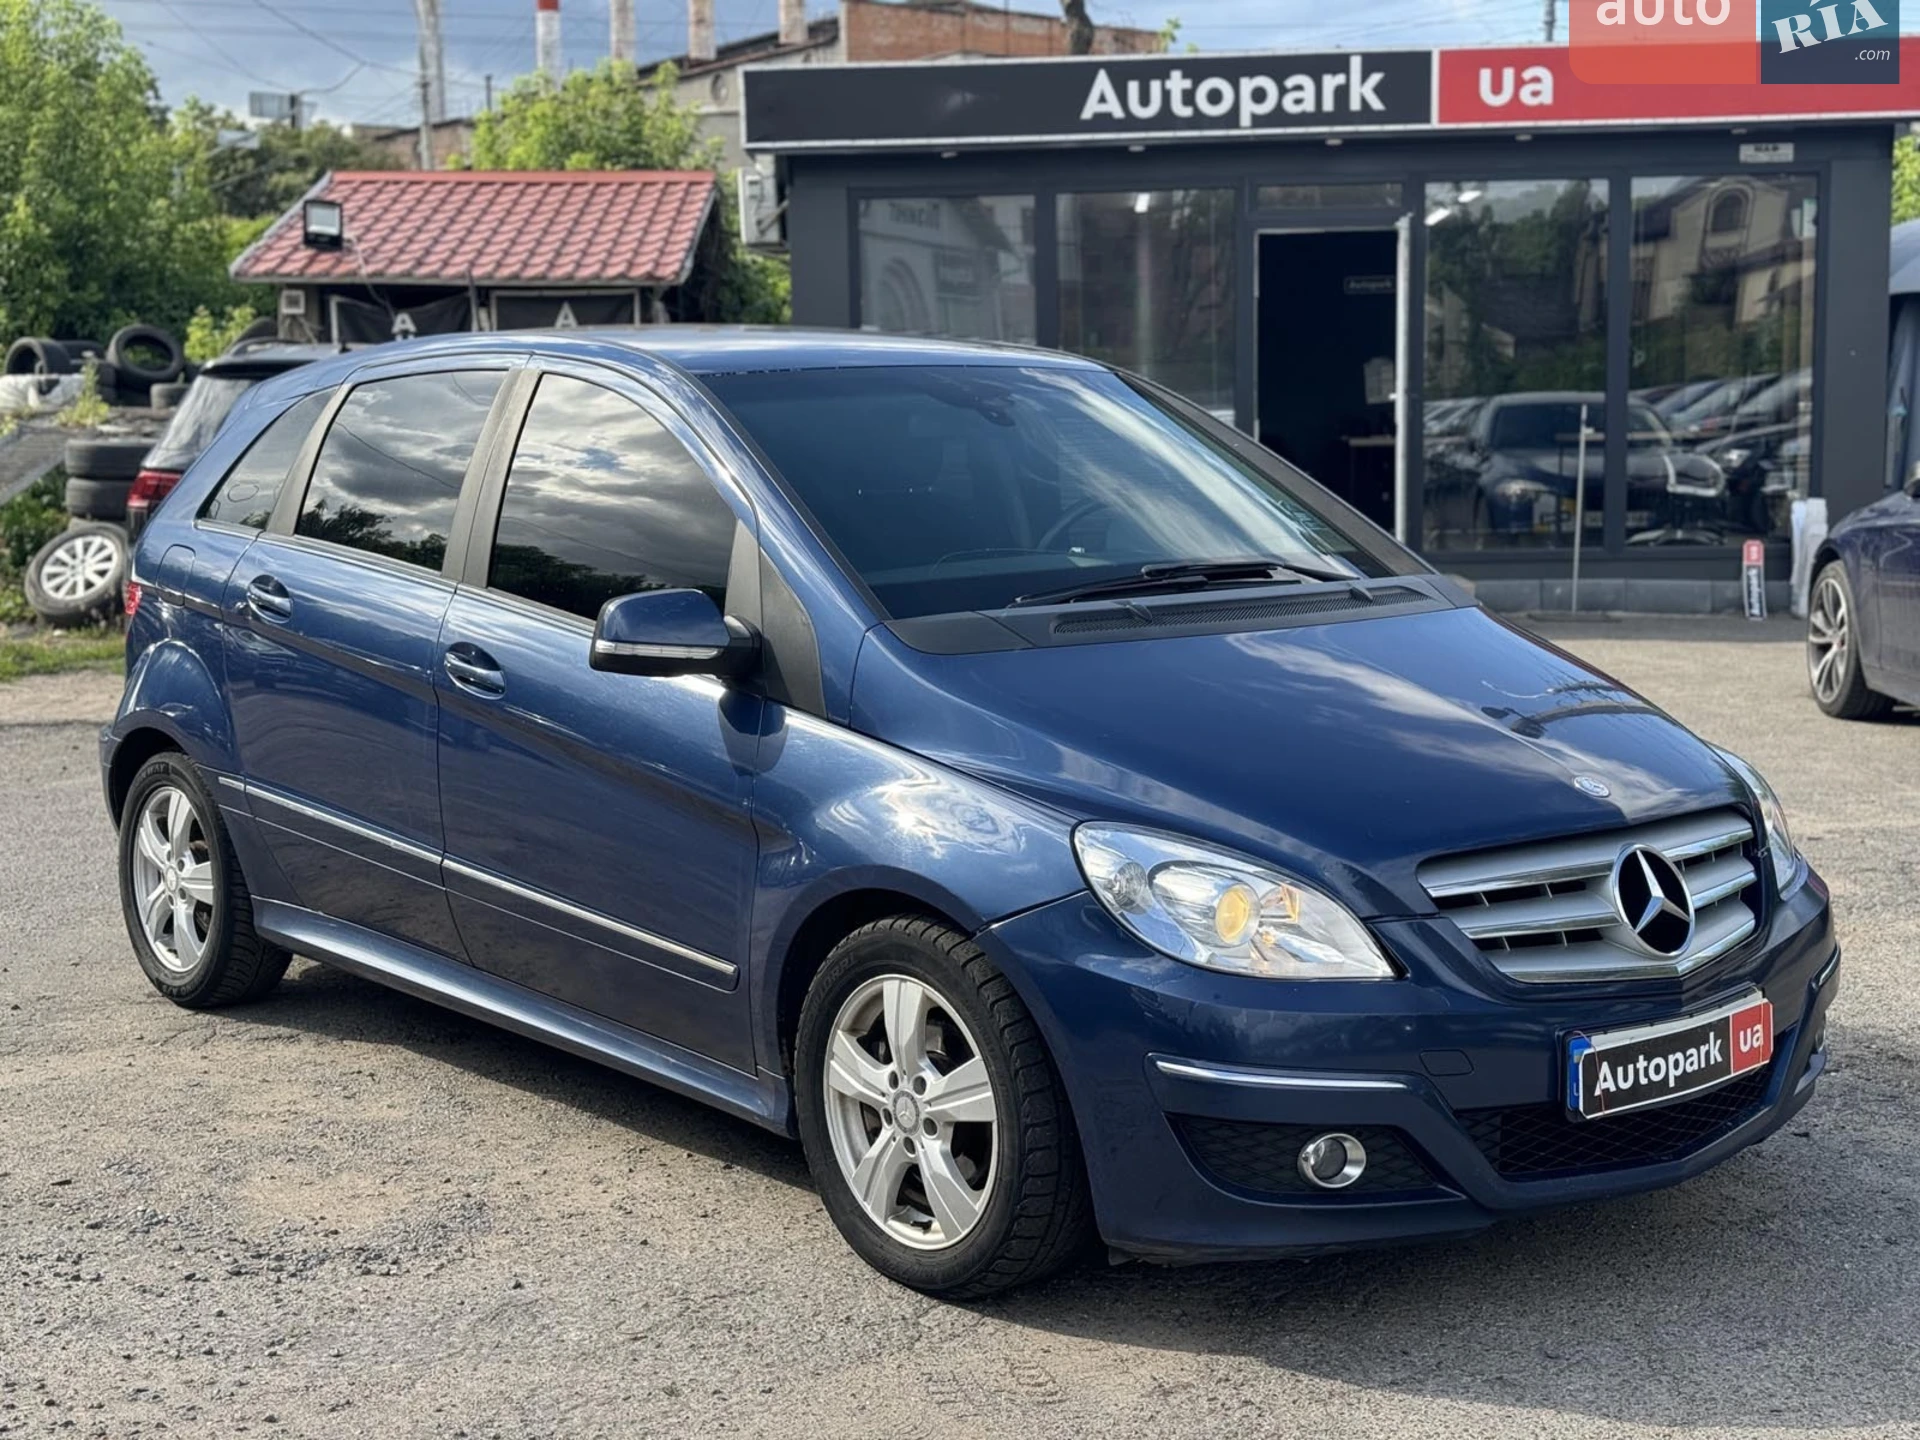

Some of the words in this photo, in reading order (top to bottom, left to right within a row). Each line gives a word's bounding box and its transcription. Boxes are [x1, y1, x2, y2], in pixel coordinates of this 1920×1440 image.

[1080, 55, 1386, 128] Autopark
[1478, 65, 1554, 107] ua
[554, 301, 579, 329] A
[1594, 1032, 1723, 1096] Autopark
[1739, 1023, 1764, 1053] ua
